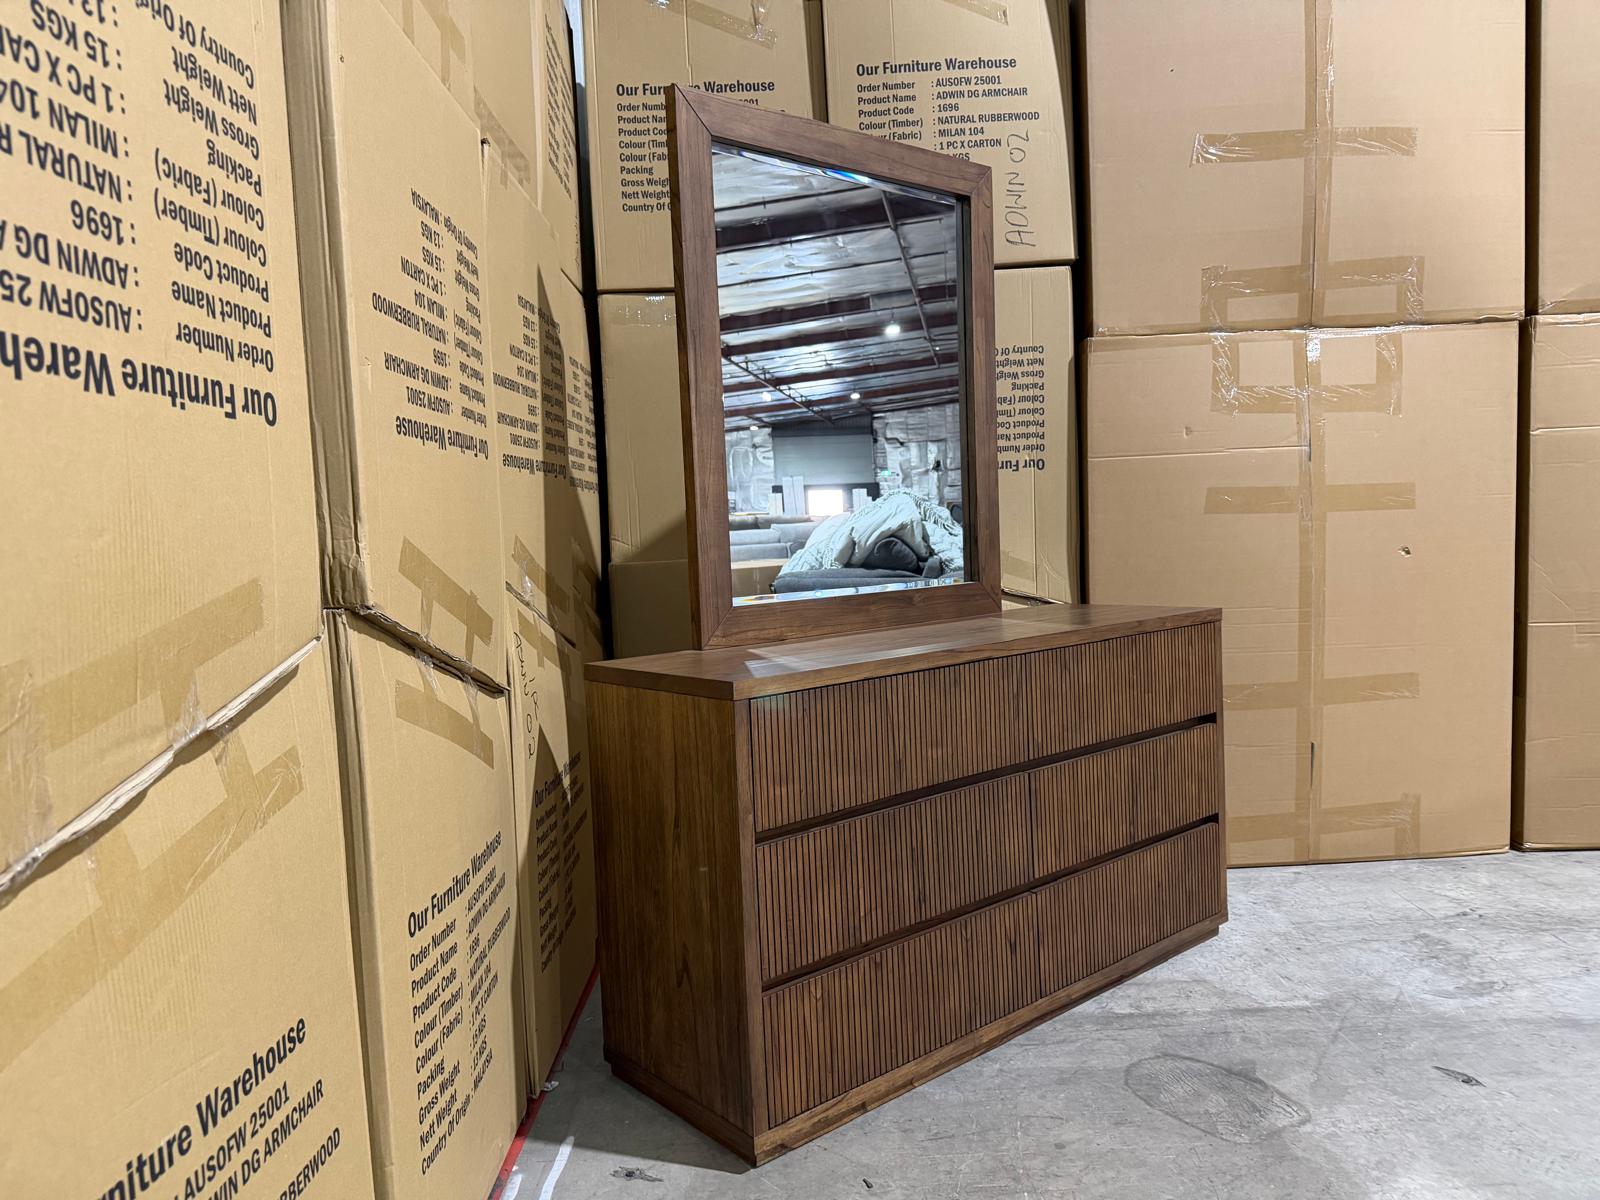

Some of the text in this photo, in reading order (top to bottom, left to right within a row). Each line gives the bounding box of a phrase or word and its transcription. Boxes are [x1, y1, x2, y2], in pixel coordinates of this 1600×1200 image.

[30, 0, 79, 51] KGS
[83, 30, 110, 68] 15
[178, 15, 255, 90] Country Of
[857, 57, 1017, 77] Our Furniture Warehouse
[171, 46, 257, 126] Nett Weight
[617, 84, 640, 97] Our
[704, 80, 775, 94] Warehouse
[857, 76, 1002, 94] Order Number AUSOFW 25001
[858, 88, 1028, 106] Product Name ADWIN DG ARMCHAIR
[163, 78, 220, 137] Weight
[617, 103, 641, 112] Order
[618, 115, 651, 125] Product
[859, 103, 960, 119] Product Code 1696
[859, 112, 1040, 131] Colour (Timber) NATURAL RUBBERWOOD
[45, 50, 262, 198] Packing 1 PC X
[47, 97, 119, 159] MILAN
[221, 116, 260, 161] Gross
[619, 128, 651, 137] Product
[888, 131, 922, 141] (Fabric)
[939, 128, 966, 138] MILAN
[969, 127, 985, 136] 104
[619, 140, 647, 150] Colour
[620, 153, 647, 163] Colour
[940, 139, 1002, 151] 1 PC X CARTON
[154, 147, 218, 209] (Fabric)
[620, 166, 654, 176] Packing
[621, 179, 645, 188] Gross
[18, 129, 267, 268] Colour (Timber) NATURAL
[220, 189, 265, 232] Colour
[410, 187, 440, 226] MALAYSIA
[622, 190, 669, 201] Nett Weight
[623, 202, 666, 213] Country Of
[420, 220, 441, 249] 13 KGS
[70, 199, 270, 303] Product Code 1696
[421, 245, 442, 273] 15 KGS
[14, 225, 272, 339] Product Name ADWIN DG
[400, 255, 426, 286] CARTON
[425, 271, 431, 290] X
[430, 275, 439, 295] PC
[438, 280, 444, 297] 1
[371, 292, 447, 345] NATURAL RUBBERWOOD
[414, 289, 446, 322] MILAN 104
[39, 281, 274, 373] Order Number AUSOFW
[1001, 346, 1045, 357] Country Of
[1027, 358, 1045, 367] Nett
[383, 351, 449, 392] ADWIN DG ARMCHAIR
[1011, 382, 1045, 392] Packing
[1021, 370, 1045, 379] Gross
[121, 358, 237, 420] Furniture
[405, 385, 451, 416] AUSOFW 25001
[1018, 395, 1045, 405] Colour
[241, 386, 277, 427] Our
[1018, 408, 1045, 417] Colour
[395, 415, 489, 461] Our Furniture Warehouse
[1013, 420, 1045, 430] Product
[1013, 432, 1045, 442] Product
[1022, 444, 1046, 453] Order
[1023, 459, 1046, 471] Our
[407, 830, 502, 938] Our Furniture Warehouse
[409, 942, 431, 972] Order
[431, 918, 457, 952] Number
[411, 957, 440, 998] Product
[439, 941, 458, 970] Name
[412, 982, 441, 1024] Product
[441, 967, 457, 993] Code
[414, 981, 464, 1049] Colour (Timber)
[415, 1038, 439, 1075] Colour
[439, 1005, 464, 1050] (Fabric)
[196, 1018, 306, 1137] Warehouse
[417, 1055, 445, 1101] Packing
[418, 1091, 439, 1126] Gross
[438, 1059, 461, 1098] Weight
[241, 1079, 324, 1186] DG ARMCHAIR
[419, 1119, 436, 1152] Nett
[435, 1087, 458, 1129] Weight
[184, 1122, 248, 1200] AUSOFW
[250, 1080, 290, 1138] 25001
[421, 1130, 447, 1176] Country
[447, 1113, 455, 1137] Of
